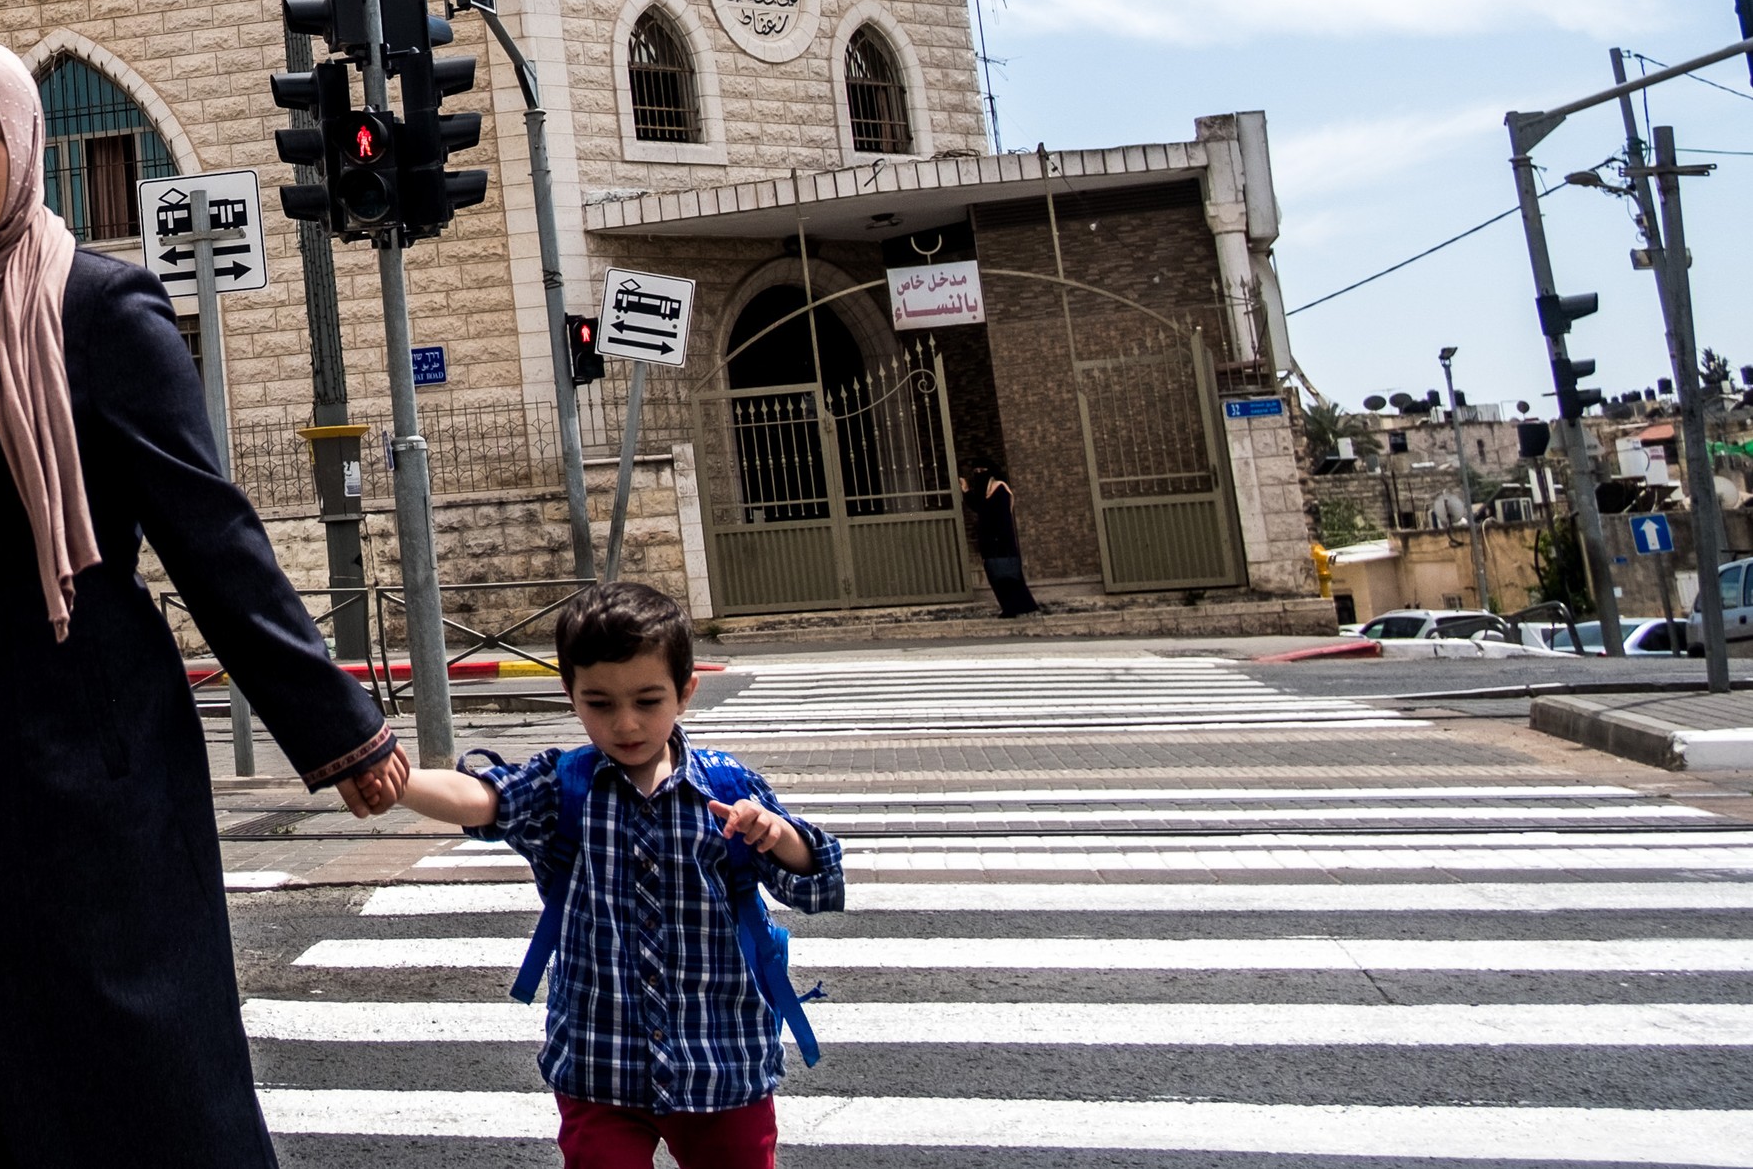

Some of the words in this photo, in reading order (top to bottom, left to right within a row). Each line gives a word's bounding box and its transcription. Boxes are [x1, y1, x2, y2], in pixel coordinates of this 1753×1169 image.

[896, 274, 925, 296] خاص
[928, 271, 968, 292] مدخل
[894, 292, 978, 322] بالنساء
[425, 351, 440, 363] דרך
[426, 371, 444, 380] ROAD
